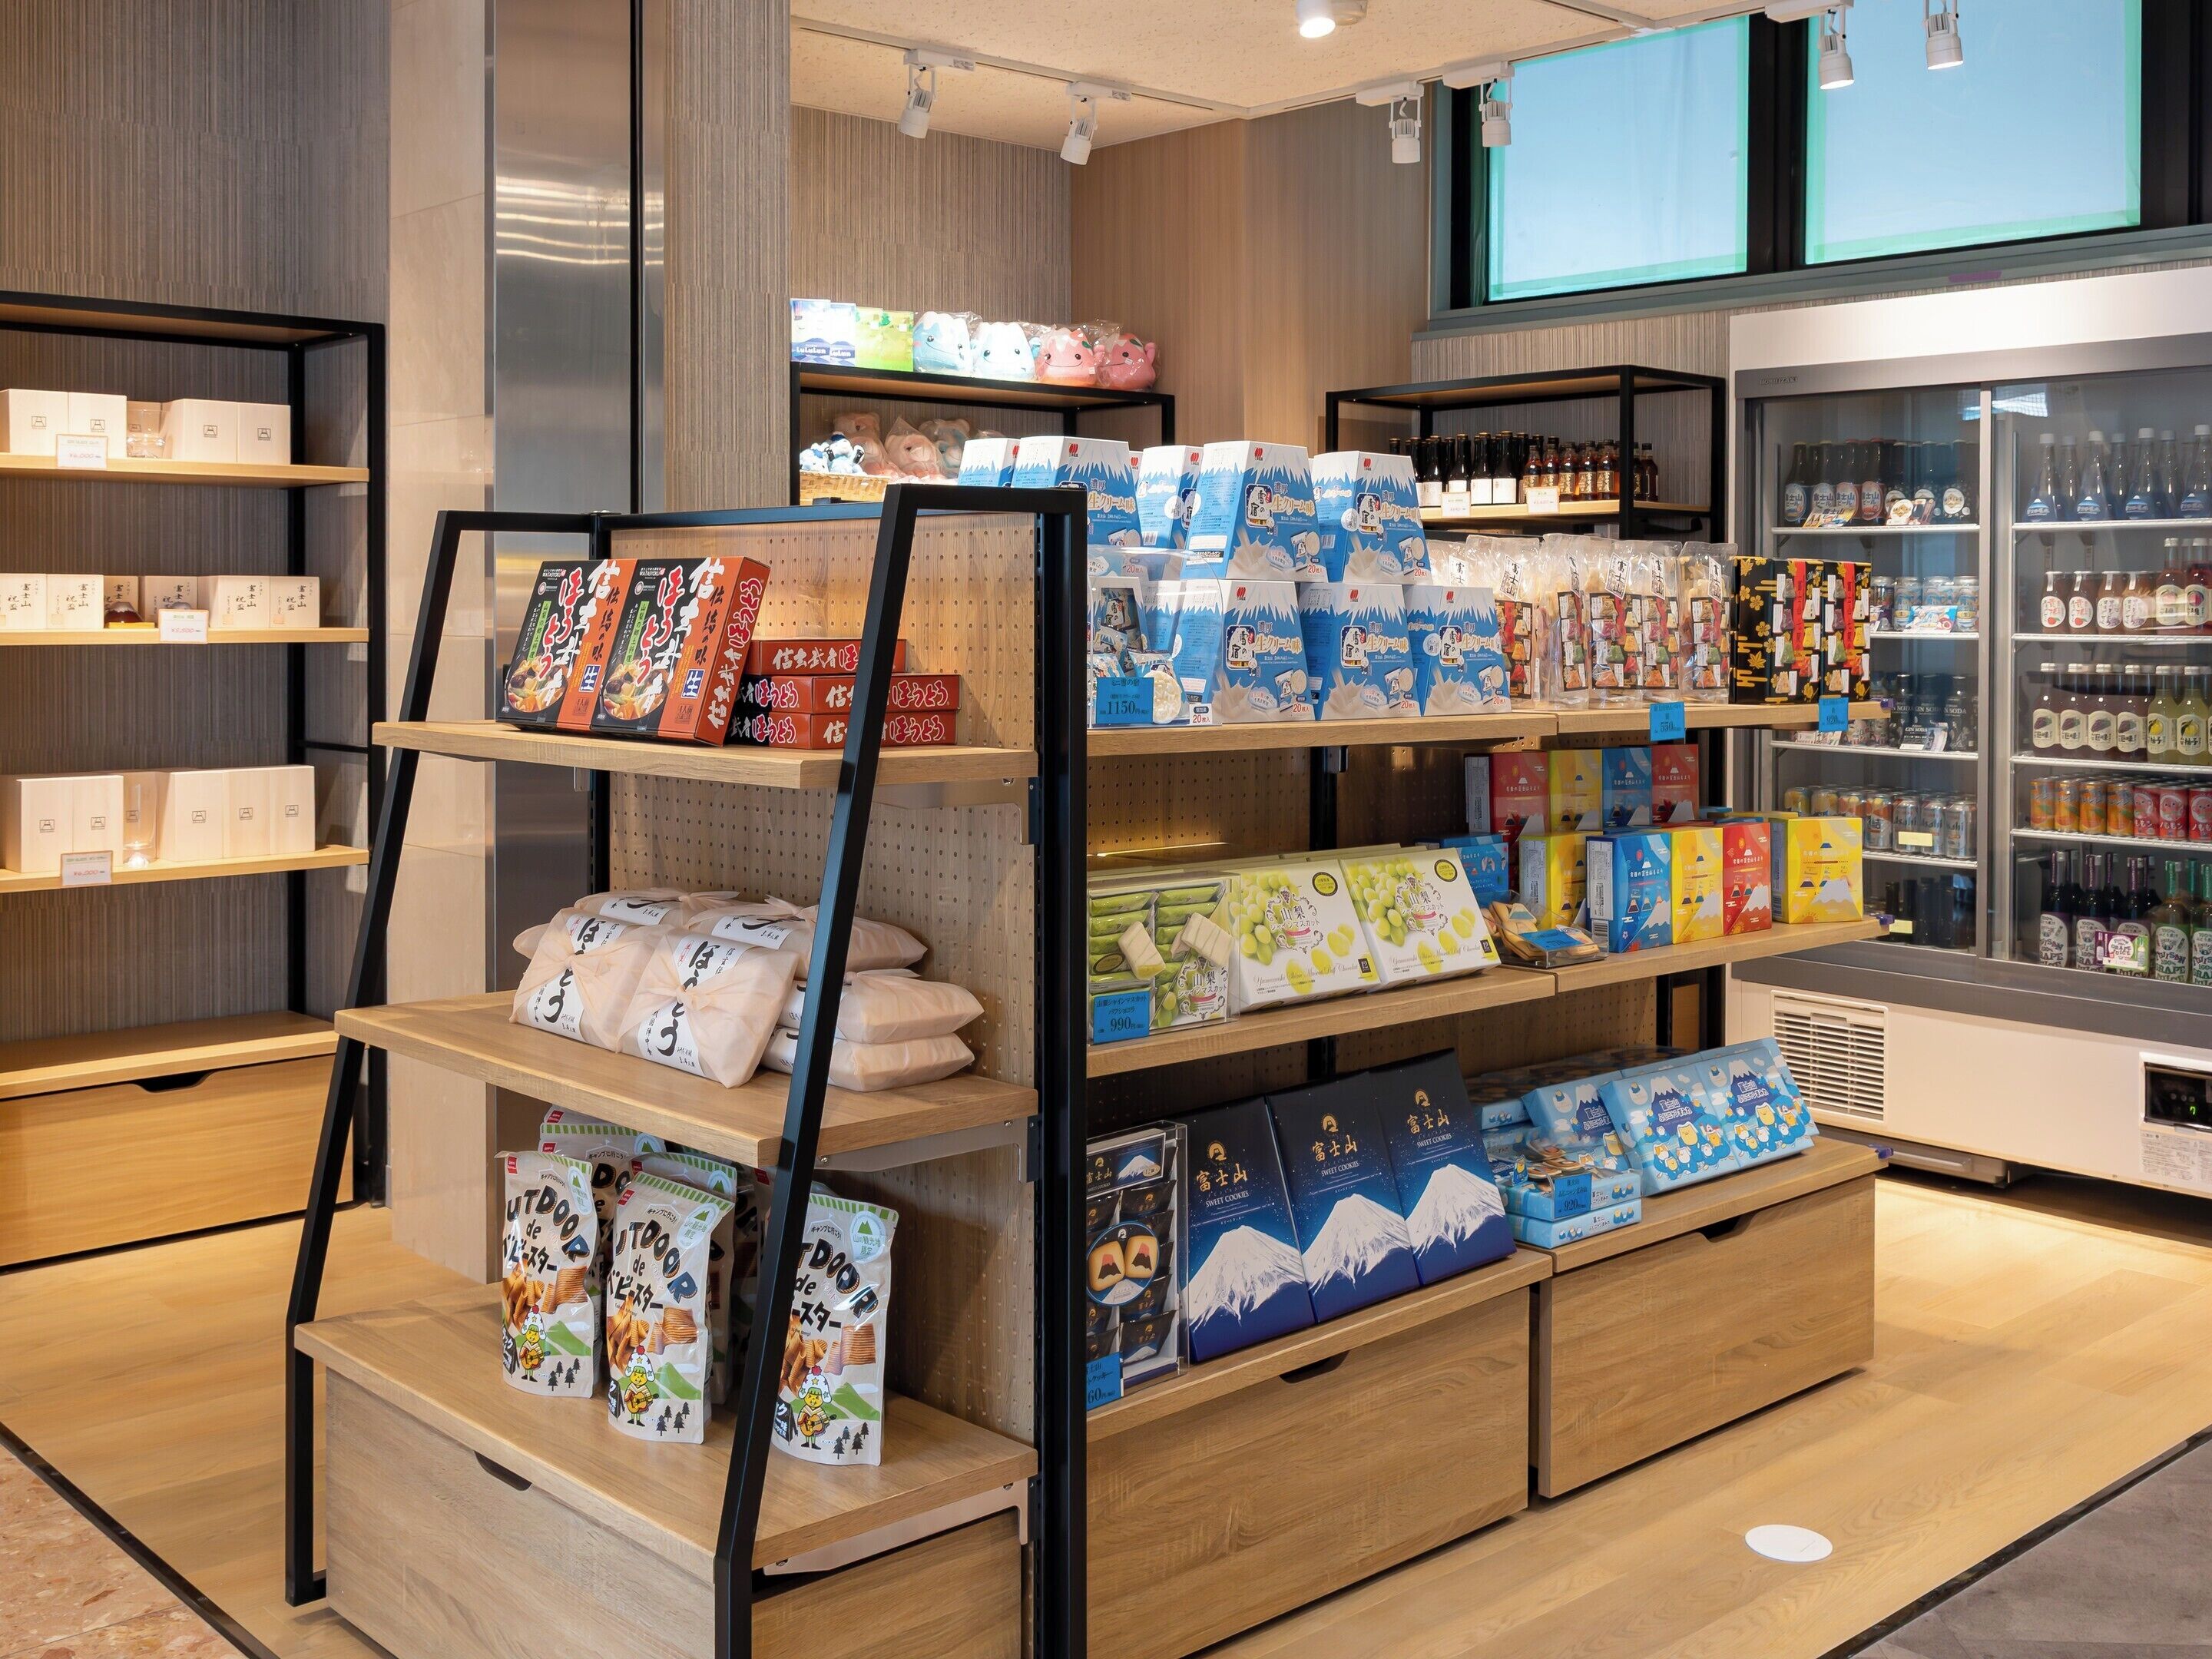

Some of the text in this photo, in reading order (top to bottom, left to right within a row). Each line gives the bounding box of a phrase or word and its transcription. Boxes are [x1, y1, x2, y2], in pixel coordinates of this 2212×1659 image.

[1250, 490, 1266, 522] 雪の宿
[1273, 497, 1315, 517] 生クリーム味
[1360, 498, 1375, 528] 雪の宿
[1506, 561, 1520, 597] 富士山
[1230, 631, 1248, 659] 雪の宿
[1256, 634, 1302, 654] 生クリーム味
[1346, 631, 1359, 657] 雪の宿
[1367, 637, 1408, 654] 生クリーム味
[1442, 631, 1456, 657] 雪の宿
[580, 666, 599, 691] 生
[683, 671, 701, 697] 生
[1193, 714, 1210, 723] 20枚入
[1281, 906, 1305, 920] 山梨
[1193, 971, 1215, 987] 山梨
[1407, 1109, 1450, 1134] 富士山
[1312, 1134, 1359, 1162] 富士山
[1416, 1133, 1452, 1148] SWEET COOKIES
[1196, 1163, 1249, 1192] 富士山
[1321, 1161, 1359, 1177] SWEET COOKIES
[1205, 1190, 1250, 1208] SWEET COOKIES
[527, 1219, 541, 1240] de
[860, 1245, 873, 1256] 限定
[633, 1254, 645, 1277] de
[795, 1273, 816, 1296] de
